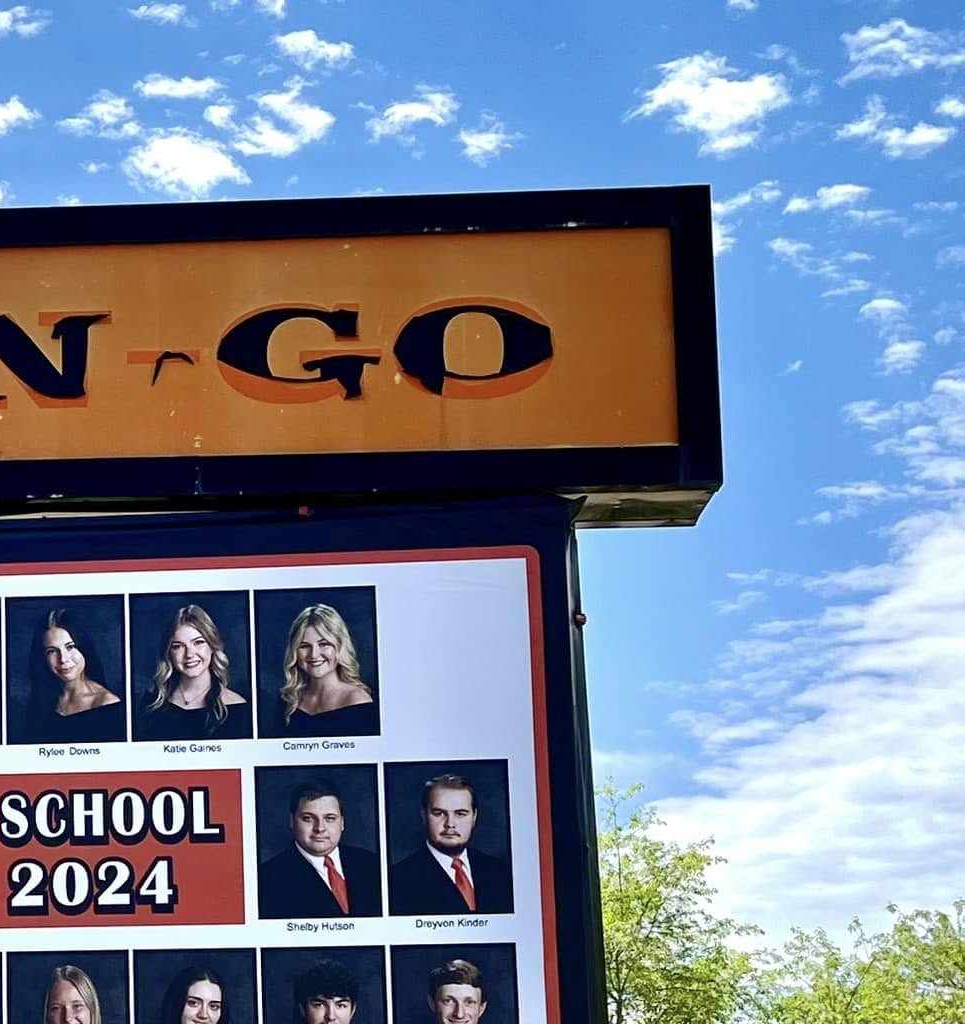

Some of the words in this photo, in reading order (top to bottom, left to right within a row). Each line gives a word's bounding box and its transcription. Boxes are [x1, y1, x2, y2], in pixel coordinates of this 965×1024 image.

[163, 744, 187, 754] Katie
[188, 743, 222, 753] Gaines
[282, 741, 320, 752] Camryn
[321, 740, 356, 750] Graves
[38, 747, 66, 759] Rylee
[69, 746, 101, 756] Downs
[6, 855, 179, 914] 2024
[286, 921, 320, 934] Shelby
[321, 921, 355, 932] Hutson
[415, 918, 455, 930] Dreyvon
[457, 918, 489, 928] Kinder
